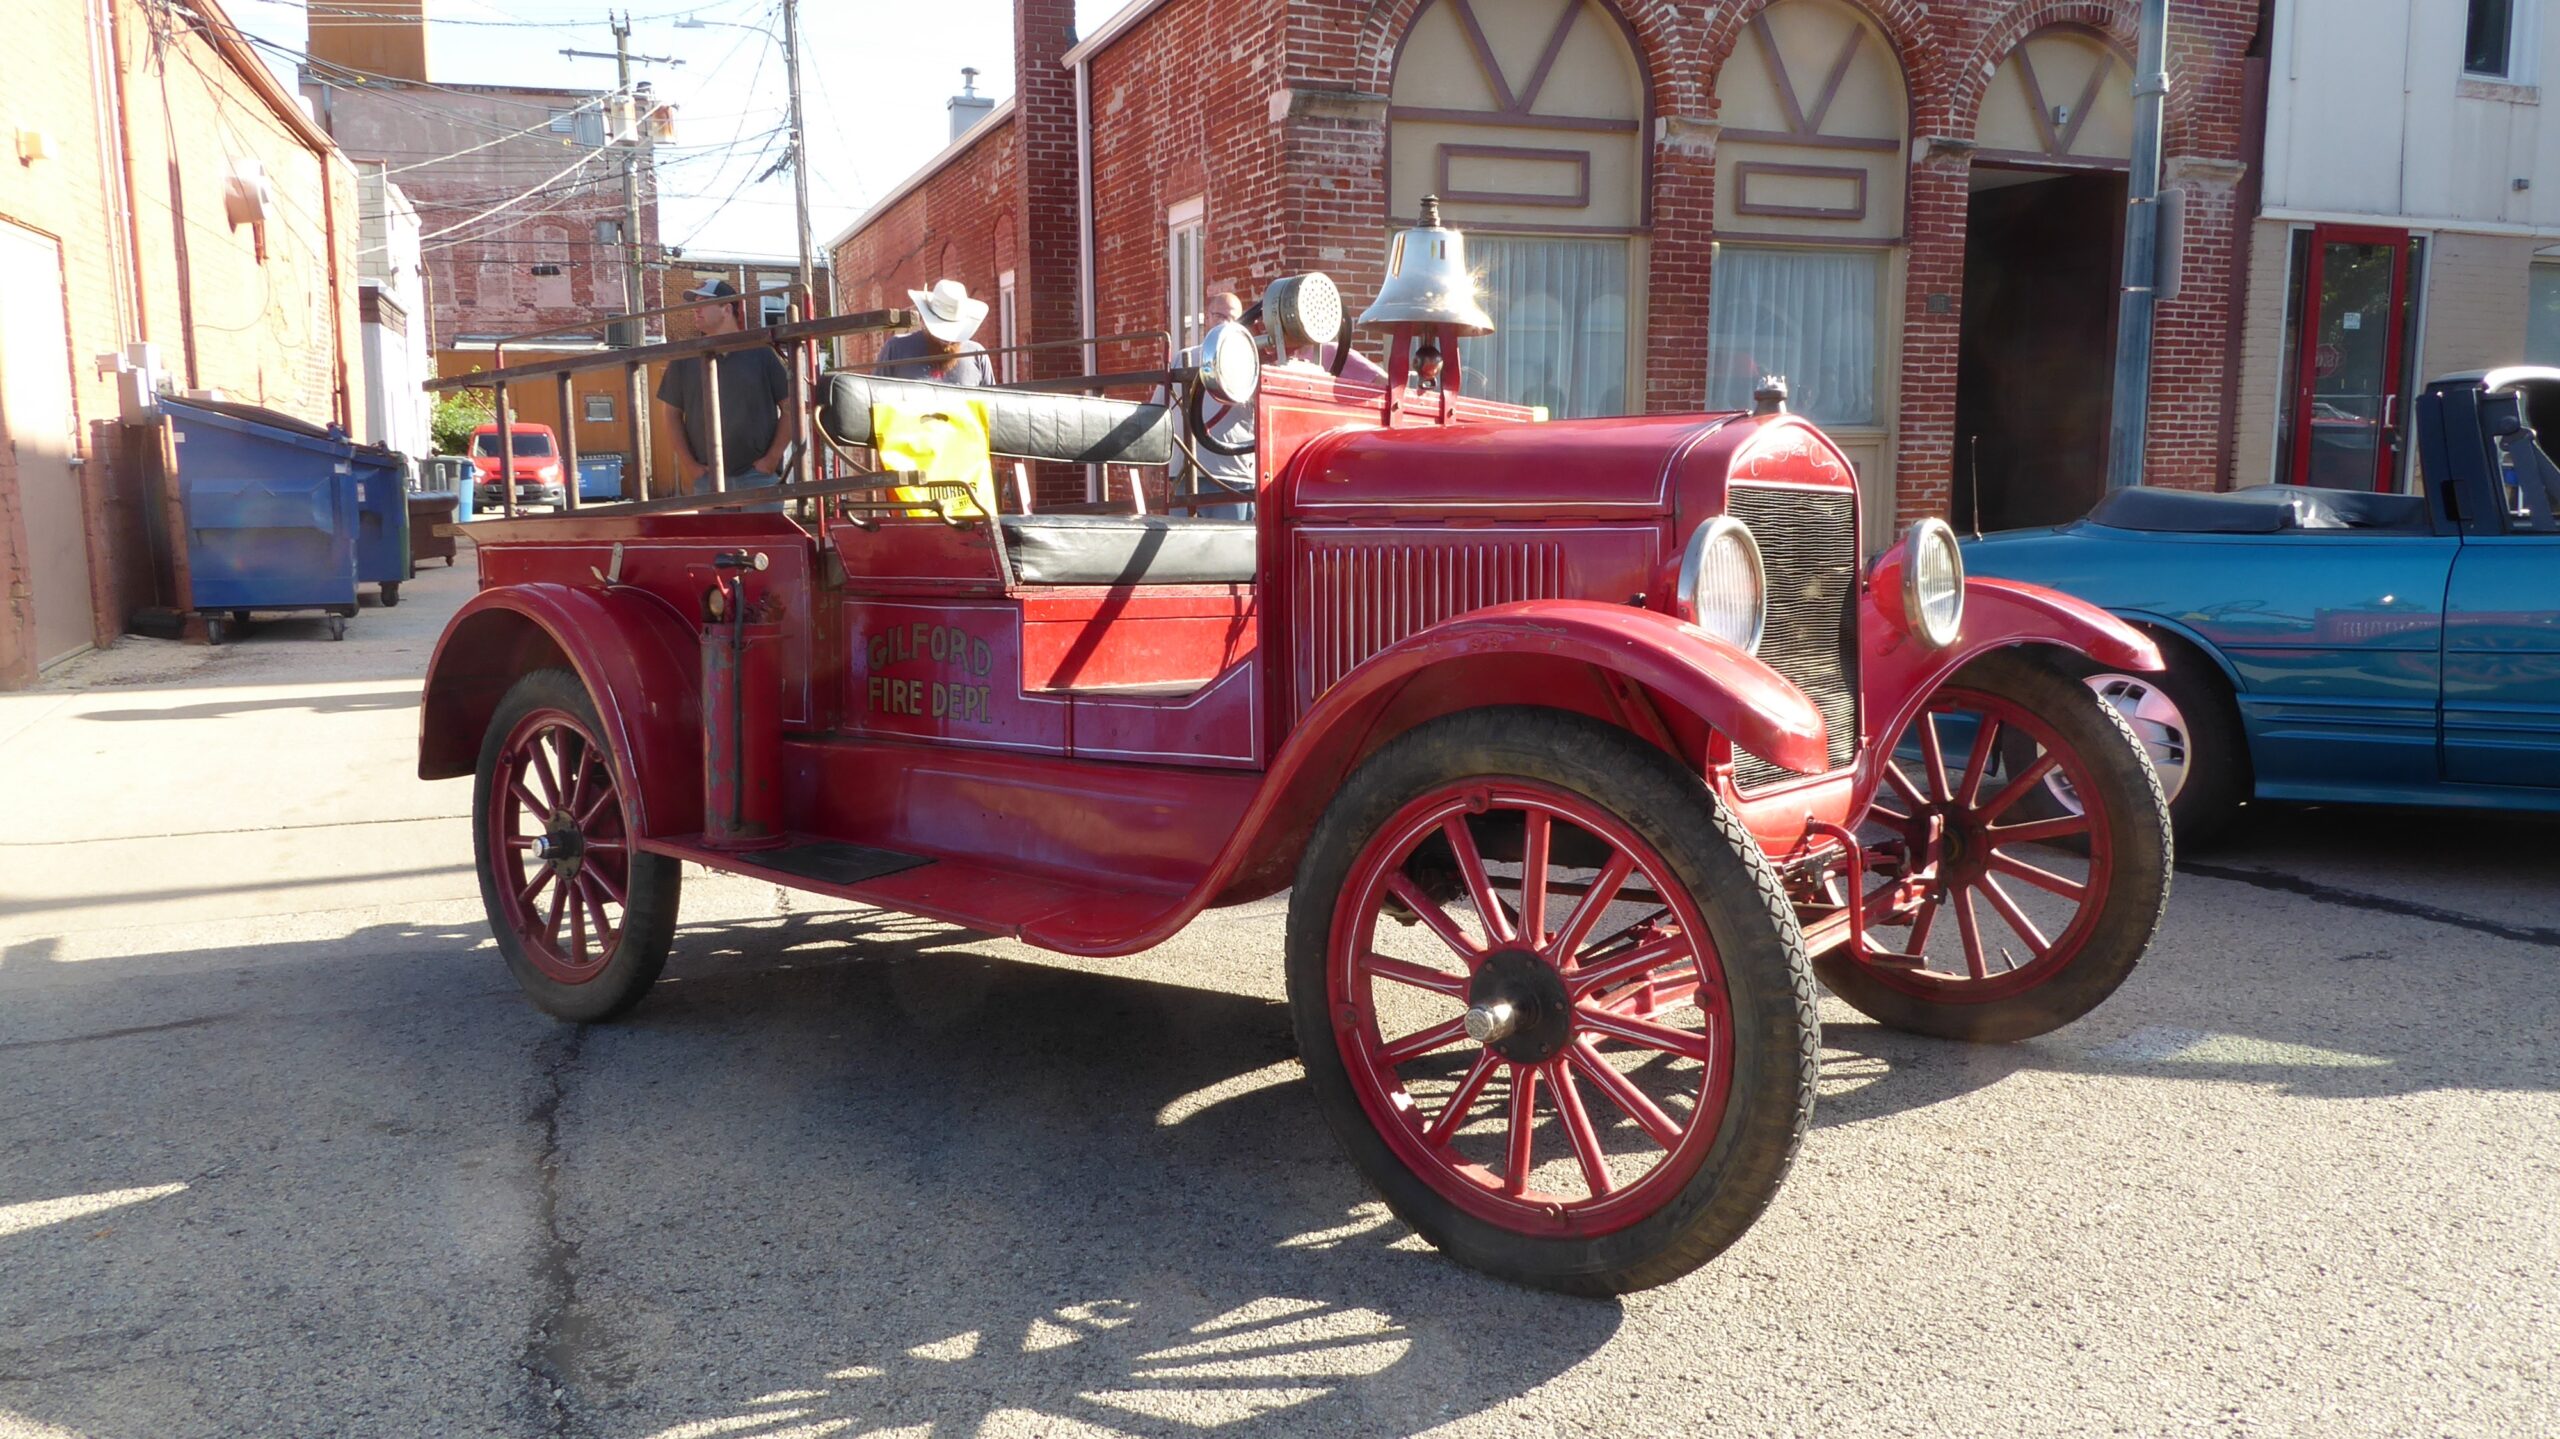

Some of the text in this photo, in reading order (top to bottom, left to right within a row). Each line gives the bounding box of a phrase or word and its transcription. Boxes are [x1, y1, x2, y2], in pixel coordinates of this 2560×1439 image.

[868, 622, 992, 677] GILFORD
[868, 676, 992, 724] FIRE DEPT.
